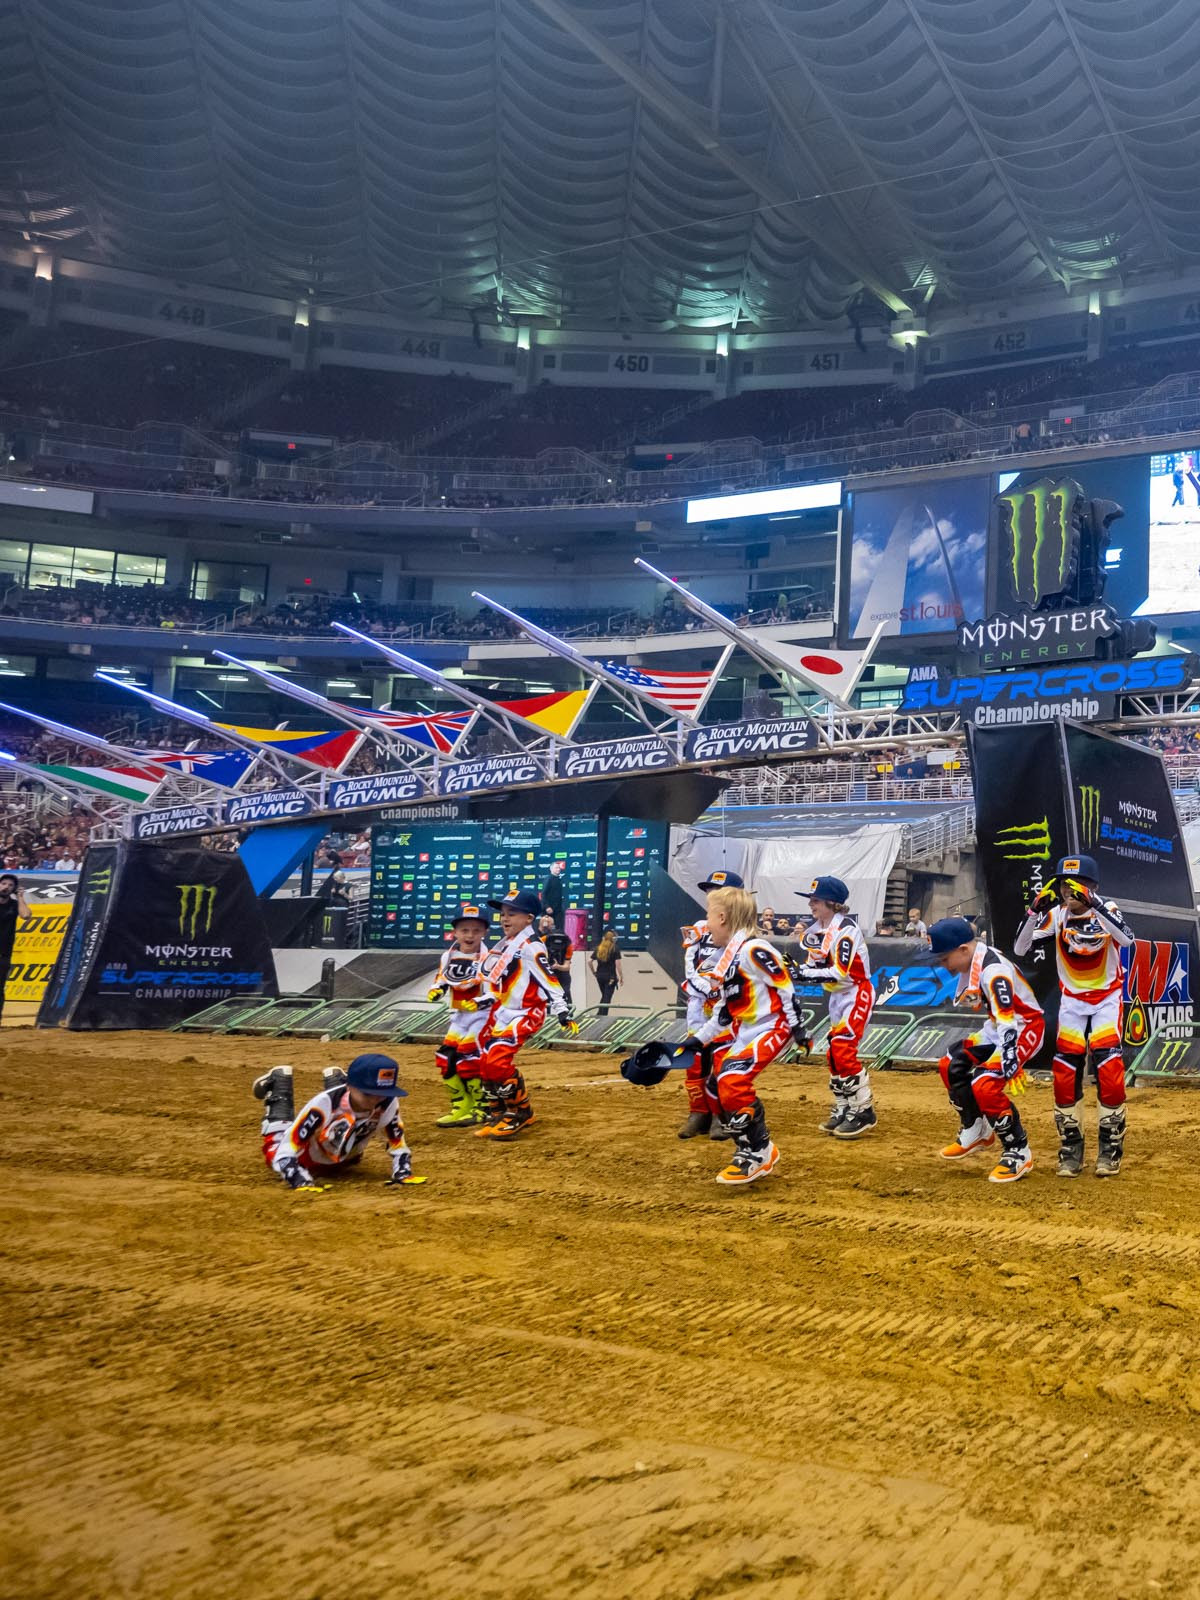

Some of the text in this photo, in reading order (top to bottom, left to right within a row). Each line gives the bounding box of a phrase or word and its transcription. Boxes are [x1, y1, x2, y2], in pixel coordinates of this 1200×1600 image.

[401, 338, 440, 359] 449
[994, 331, 1025, 352] 452
[614, 354, 649, 372] 450
[810, 353, 840, 371] 451
[962, 609, 1111, 648] MONSTER
[985, 642, 1086, 662] ENERGY
[902, 657, 1185, 709] SUPERCROSS
[910, 666, 938, 682] AMA
[975, 697, 1099, 724] Championship
[709, 721, 808, 739] ROCKY MOUNTAIN
[582, 747, 613, 759] ROCKY
[459, 763, 485, 774] ROCKY
[348, 780, 372, 791] ROCKY
[1118, 801, 1158, 822] MONSTER
[1125, 818, 1152, 829] ENERGY
[1101, 824, 1173, 853] SUPERCROSS
[1116, 846, 1158, 864] CHAMPIONSHIP
[146, 944, 232, 958] MONSTER
[842, 941, 850, 963] TLD
[101, 971, 263, 986] SUPERCROSS
[136, 988, 231, 998] CHAMPIONSHIP
[996, 980, 1010, 1004] TLD
[853, 990, 870, 1021] TLD
[1148, 1006, 1193, 1039] YEARS
